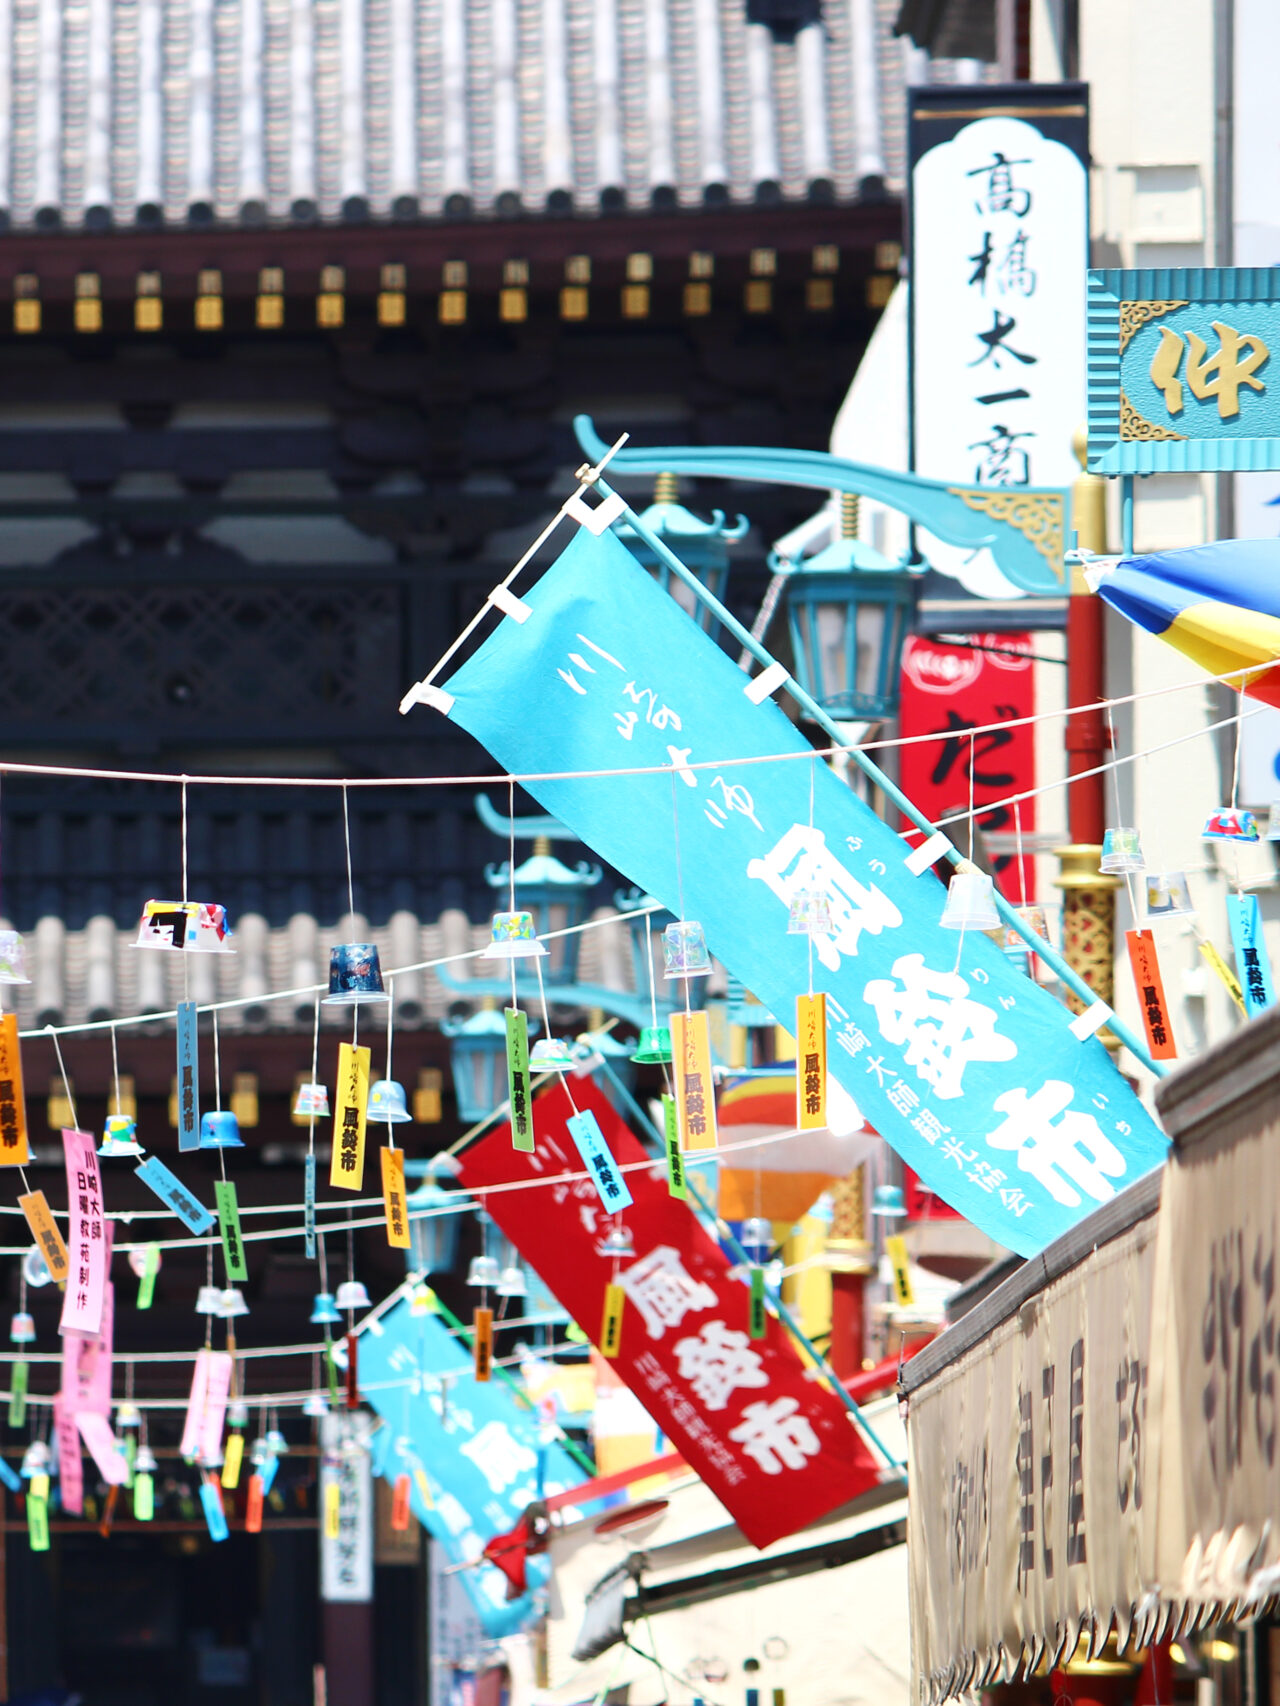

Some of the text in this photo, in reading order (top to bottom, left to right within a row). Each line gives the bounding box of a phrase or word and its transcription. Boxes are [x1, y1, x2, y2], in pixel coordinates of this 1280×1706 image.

[965, 151, 1038, 487] 高橋太一商
[1150, 320, 1270, 418] 仲
[746, 822, 1127, 1208] 風鈴市
[1142, 985, 1168, 1047] 風鈴市
[683, 1071, 708, 1137] 風鈴市
[803, 1052, 821, 1116] 風鈴市
[825, 991, 1035, 1218] 川崎大師観光協会
[340, 1106, 360, 1173] 風鈴市
[613, 1245, 822, 1476] 風鈴市
